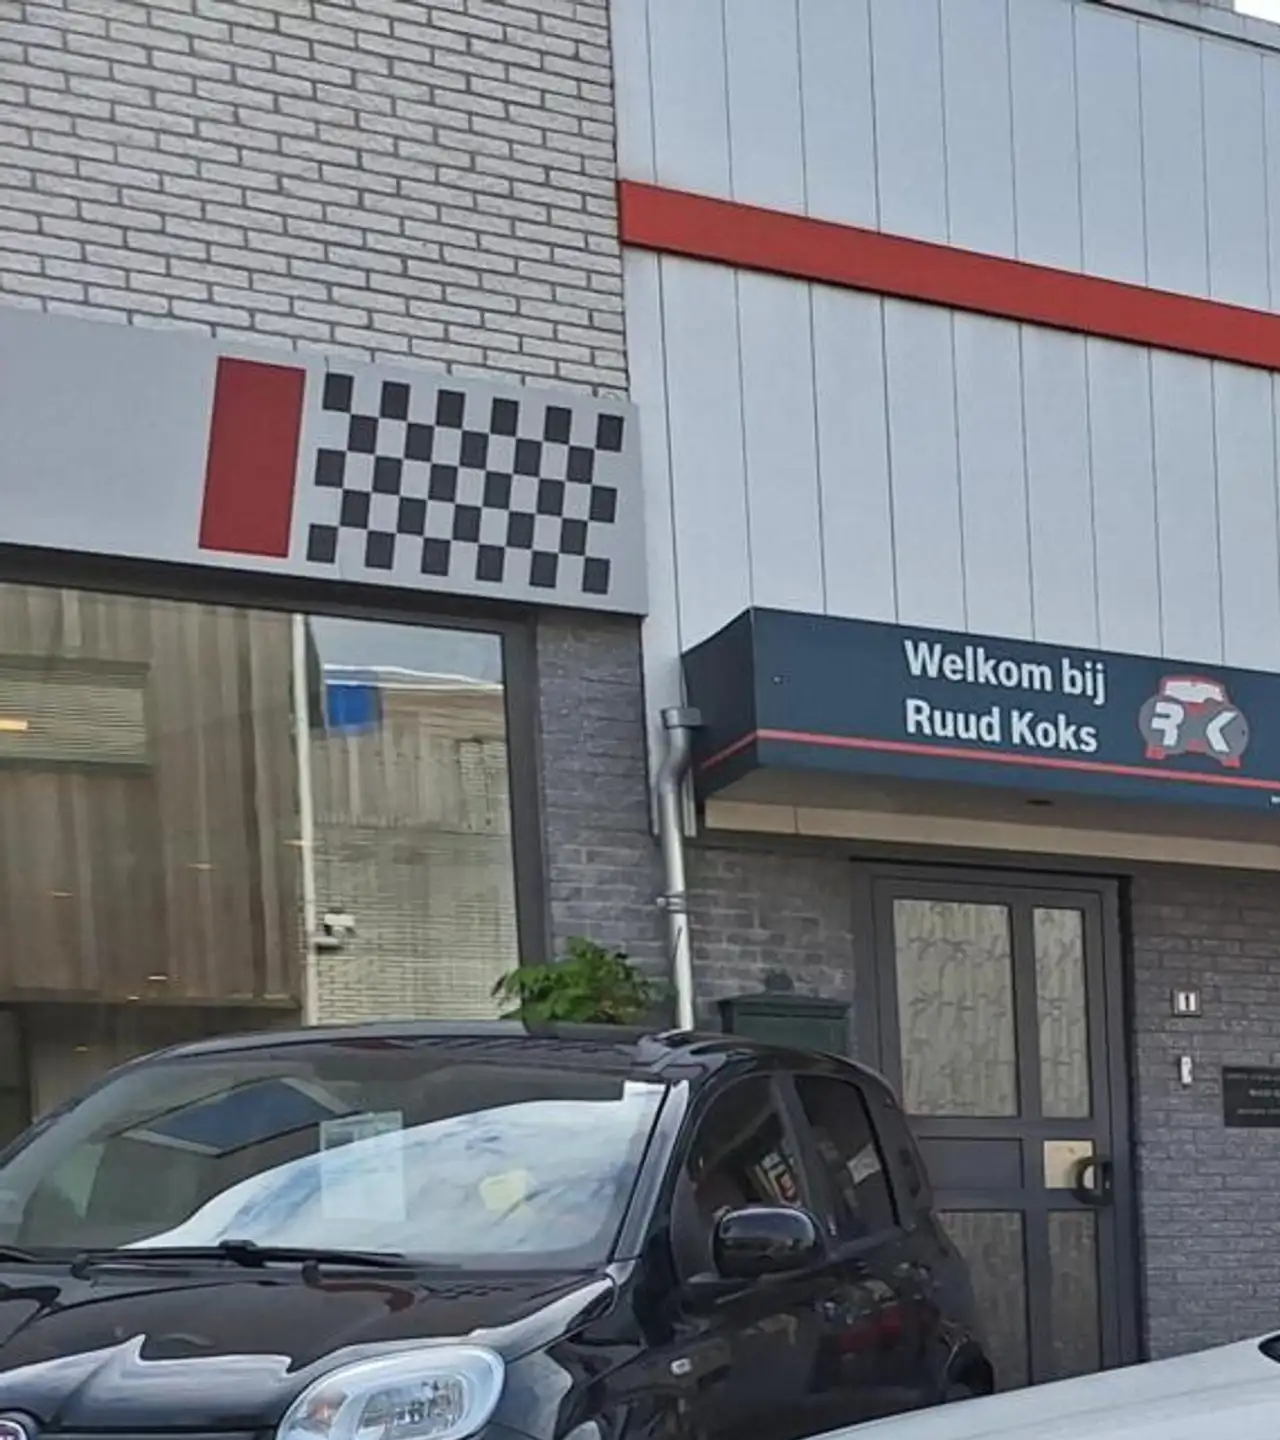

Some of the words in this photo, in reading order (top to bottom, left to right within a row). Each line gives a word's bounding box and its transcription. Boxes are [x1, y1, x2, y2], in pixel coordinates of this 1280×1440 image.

[904, 640, 1053, 691] Welkom
[1062, 658, 1106, 704] bij
[905, 699, 1000, 743] Ruud
[1011, 708, 1098, 753] Koks
